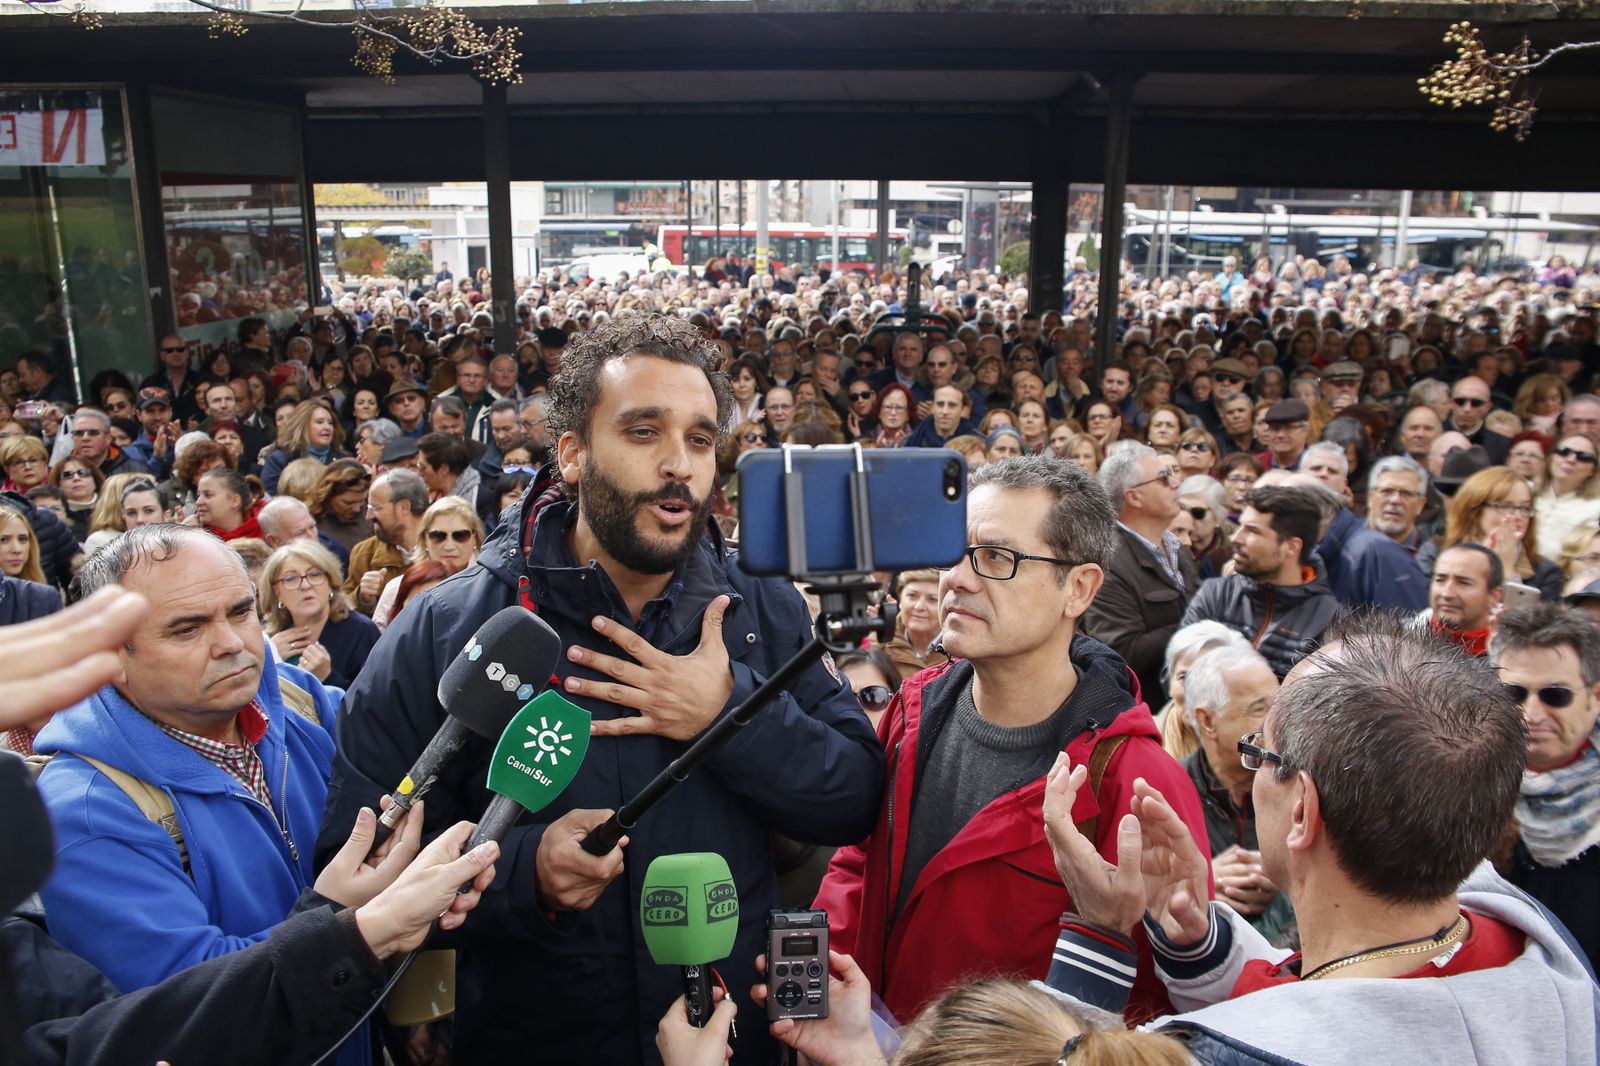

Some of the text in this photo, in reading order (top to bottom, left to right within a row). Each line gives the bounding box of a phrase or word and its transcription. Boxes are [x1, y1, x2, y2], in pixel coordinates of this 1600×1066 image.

[507, 755, 553, 787] CanalSur
[648, 895, 680, 903] ONDA
[649, 910, 681, 920] CERO
